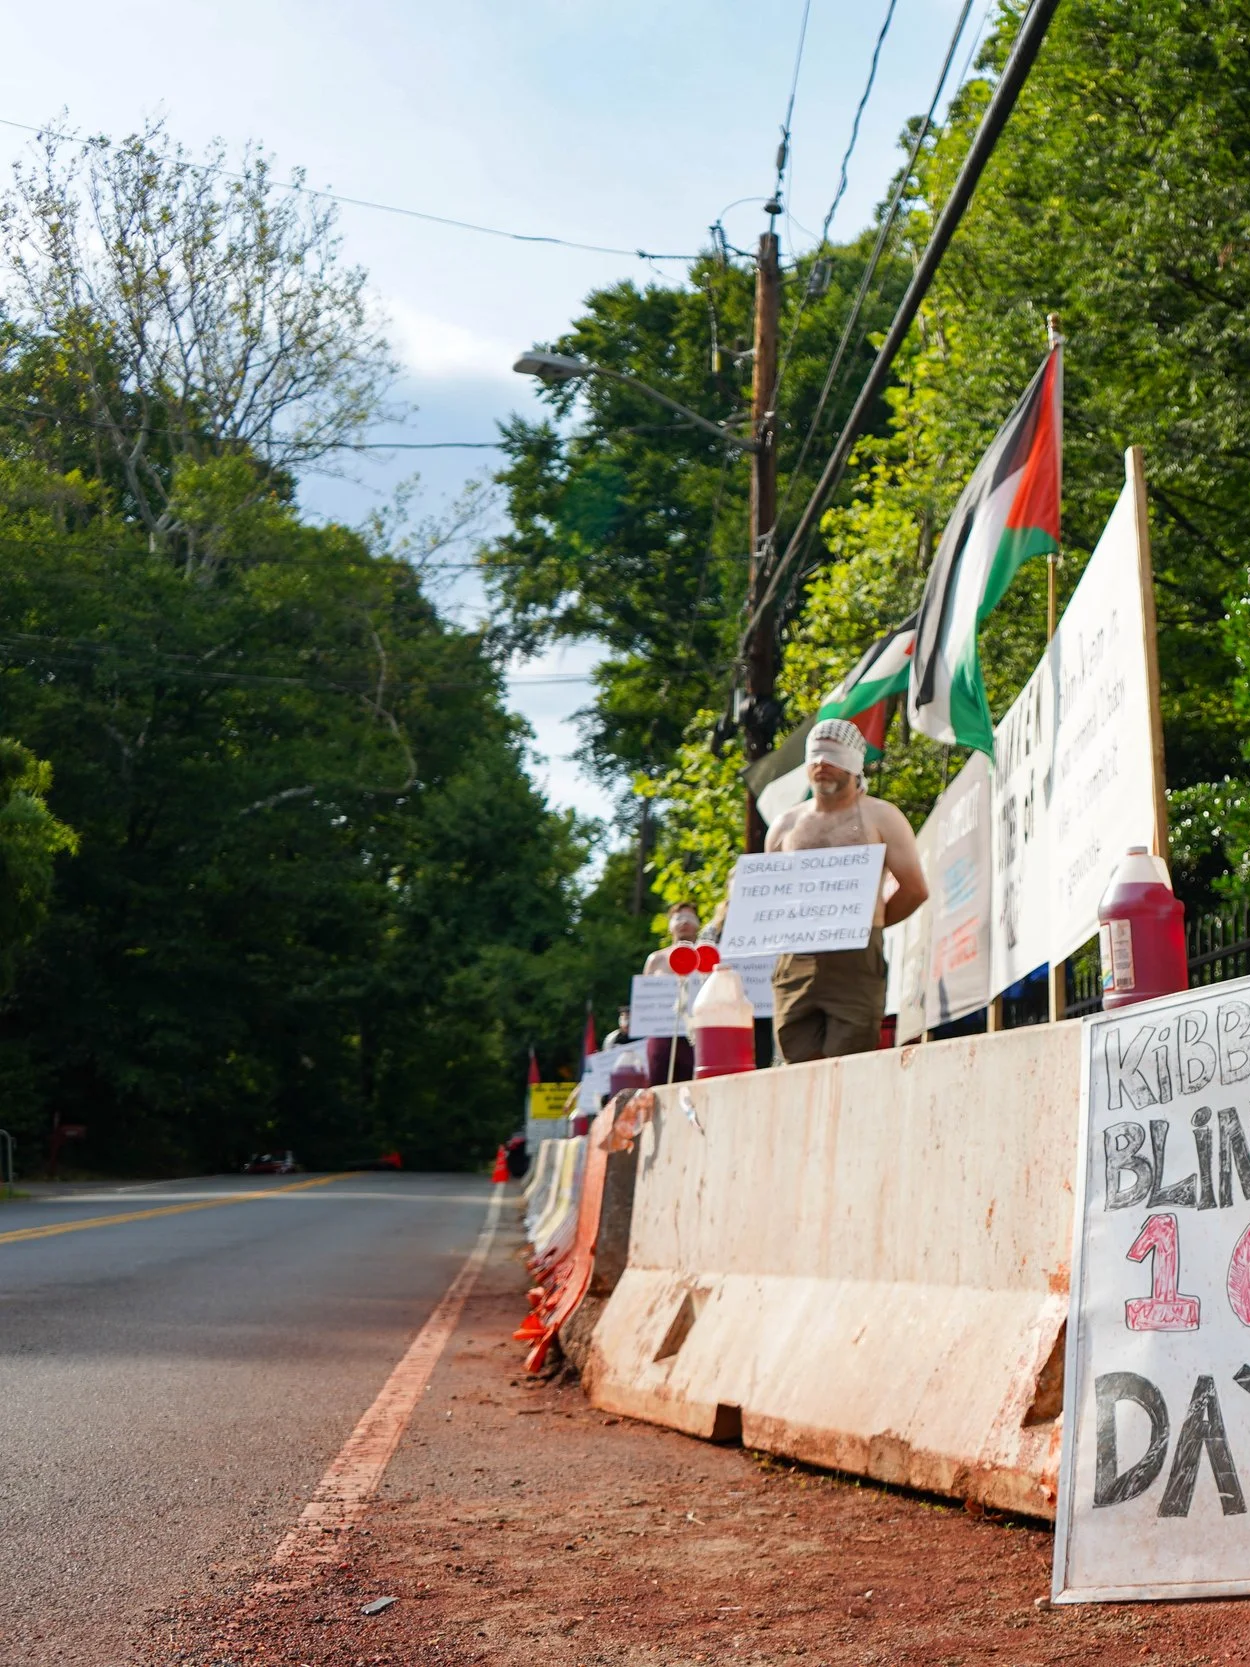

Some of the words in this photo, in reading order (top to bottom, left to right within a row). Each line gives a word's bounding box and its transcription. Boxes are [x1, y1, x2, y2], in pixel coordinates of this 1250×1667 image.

[743, 860, 793, 875] ISRAELI
[800, 853, 870, 870] SOLDIERS
[742, 885, 770, 898] TIED
[774, 883, 793, 895] ME
[798, 881, 816, 893] TO
[819, 879, 859, 892] THEIR
[753, 909, 785, 923] JEEP
[787, 907, 797, 919] &
[799, 904, 837, 918] USED
[841, 903, 862, 915] ME
[728, 935, 745, 948] AS
[746, 933, 757, 946] A
[762, 931, 816, 945] HUMAN
[817, 927, 871, 941] SHEILD
